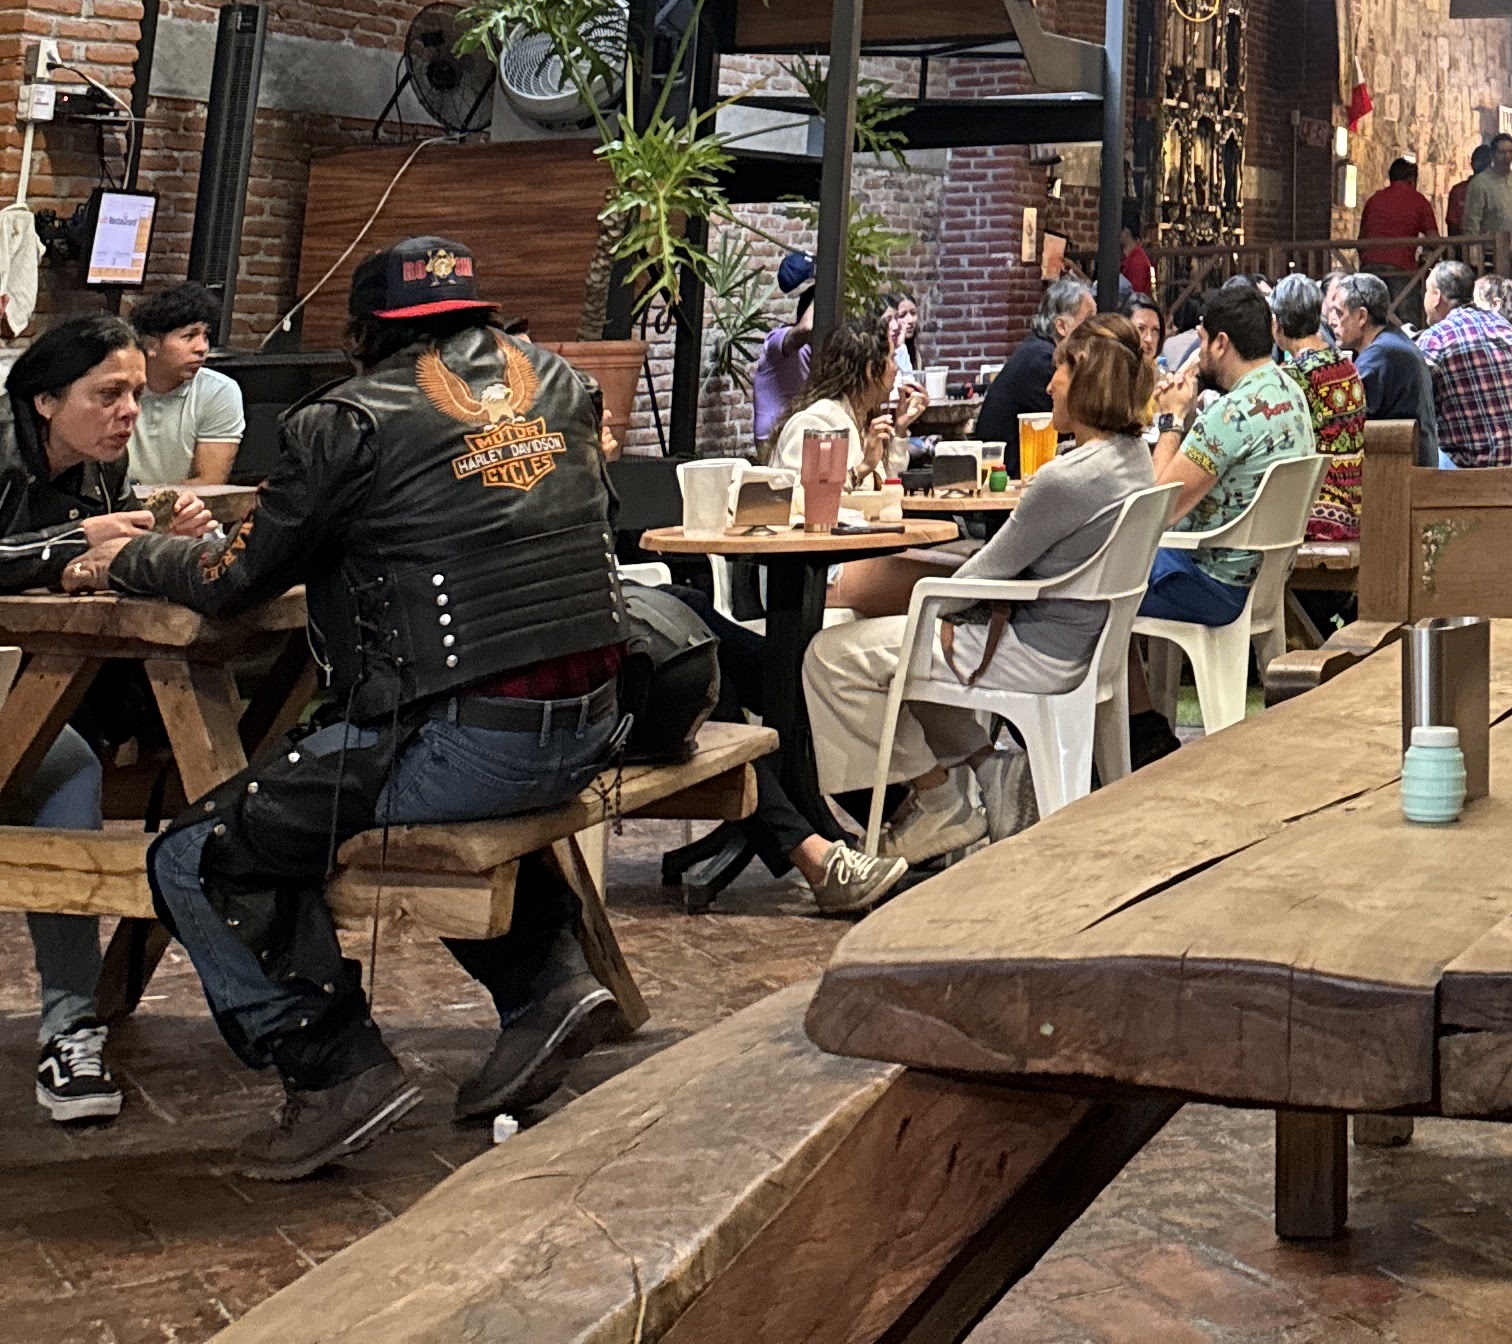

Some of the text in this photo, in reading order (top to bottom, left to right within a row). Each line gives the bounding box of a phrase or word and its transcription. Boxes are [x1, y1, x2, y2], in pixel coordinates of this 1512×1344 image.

[475, 425, 540, 449] MOTOR
[458, 436, 562, 474] HARLEY DAVIDSON
[486, 454, 551, 485] CYCLES
